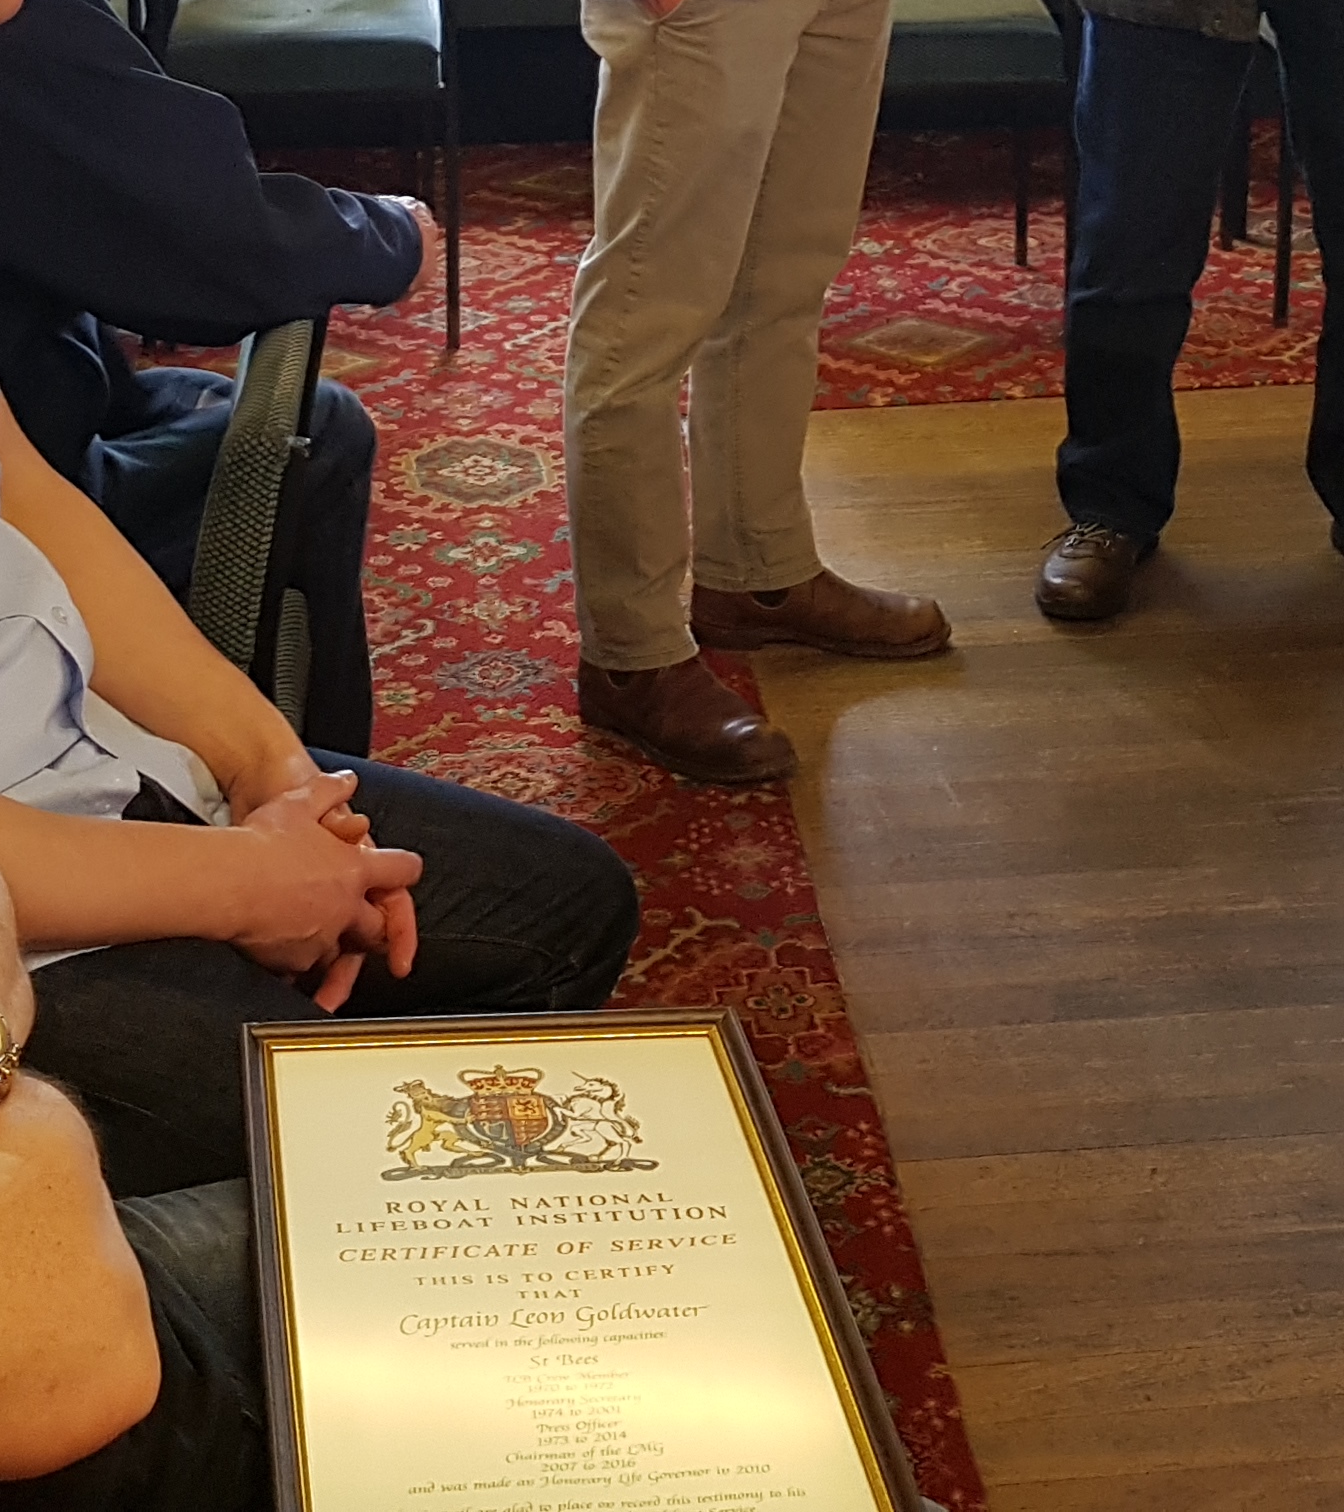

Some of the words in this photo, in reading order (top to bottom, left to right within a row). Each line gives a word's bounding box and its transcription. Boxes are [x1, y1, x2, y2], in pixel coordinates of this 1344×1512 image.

[385, 1198, 489, 1214] ROYAL
[510, 1192, 673, 1210] NATIONAL
[336, 1217, 493, 1233] LIFEBOAT
[517, 1206, 727, 1225] INSTITUTION
[339, 1243, 538, 1262] CERTIFICATE
[557, 1241, 593, 1255] OF
[610, 1233, 737, 1252] SERVICE
[415, 1275, 474, 1285] THIS
[486, 1274, 509, 1284] IS
[521, 1272, 553, 1283] TO
[565, 1264, 674, 1280] CERTIFY
[518, 1289, 581, 1299] THAT
[399, 1311, 499, 1337] Captain
[510, 1309, 565, 1328] Leon
[575, 1302, 709, 1331] Goldwater
[450, 1337, 490, 1349] served
[495, 1338, 508, 1347] in
[513, 1336, 533, 1347] the
[532, 1333, 599, 1350] following
[529, 1355, 548, 1369] St
[556, 1354, 599, 1366] Bees
[505, 1396, 575, 1409] Honorary
[536, 1423, 570, 1433] Press
[575, 1419, 621, 1434] Officer
[575, 1434, 588, 1444] to
[593, 1430, 627, 1443] 2014
[506, 1450, 576, 1464] Chairman
[582, 1446, 596, 1459] of
[600, 1445, 621, 1456] the
[541, 1462, 577, 1472] 2007
[583, 1461, 596, 1471] to
[601, 1459, 636, 1469] 2016
[408, 1480, 435, 1495] and
[440, 1482, 468, 1493] was
[473, 1476, 511, 1491] made
[516, 1479, 536, 1487] an
[539, 1473, 612, 1488] Honorary
[618, 1472, 642, 1487] Life
[647, 1468, 710, 1486] Governor
[716, 1466, 730, 1475] in
[736, 1464, 771, 1474] 2010
[621, 1495, 661, 1508] record
[666, 1493, 691, 1506] this
[697, 1490, 763, 1503] testimony
[769, 1489, 782, 1498] to
[787, 1486, 806, 1497] his
